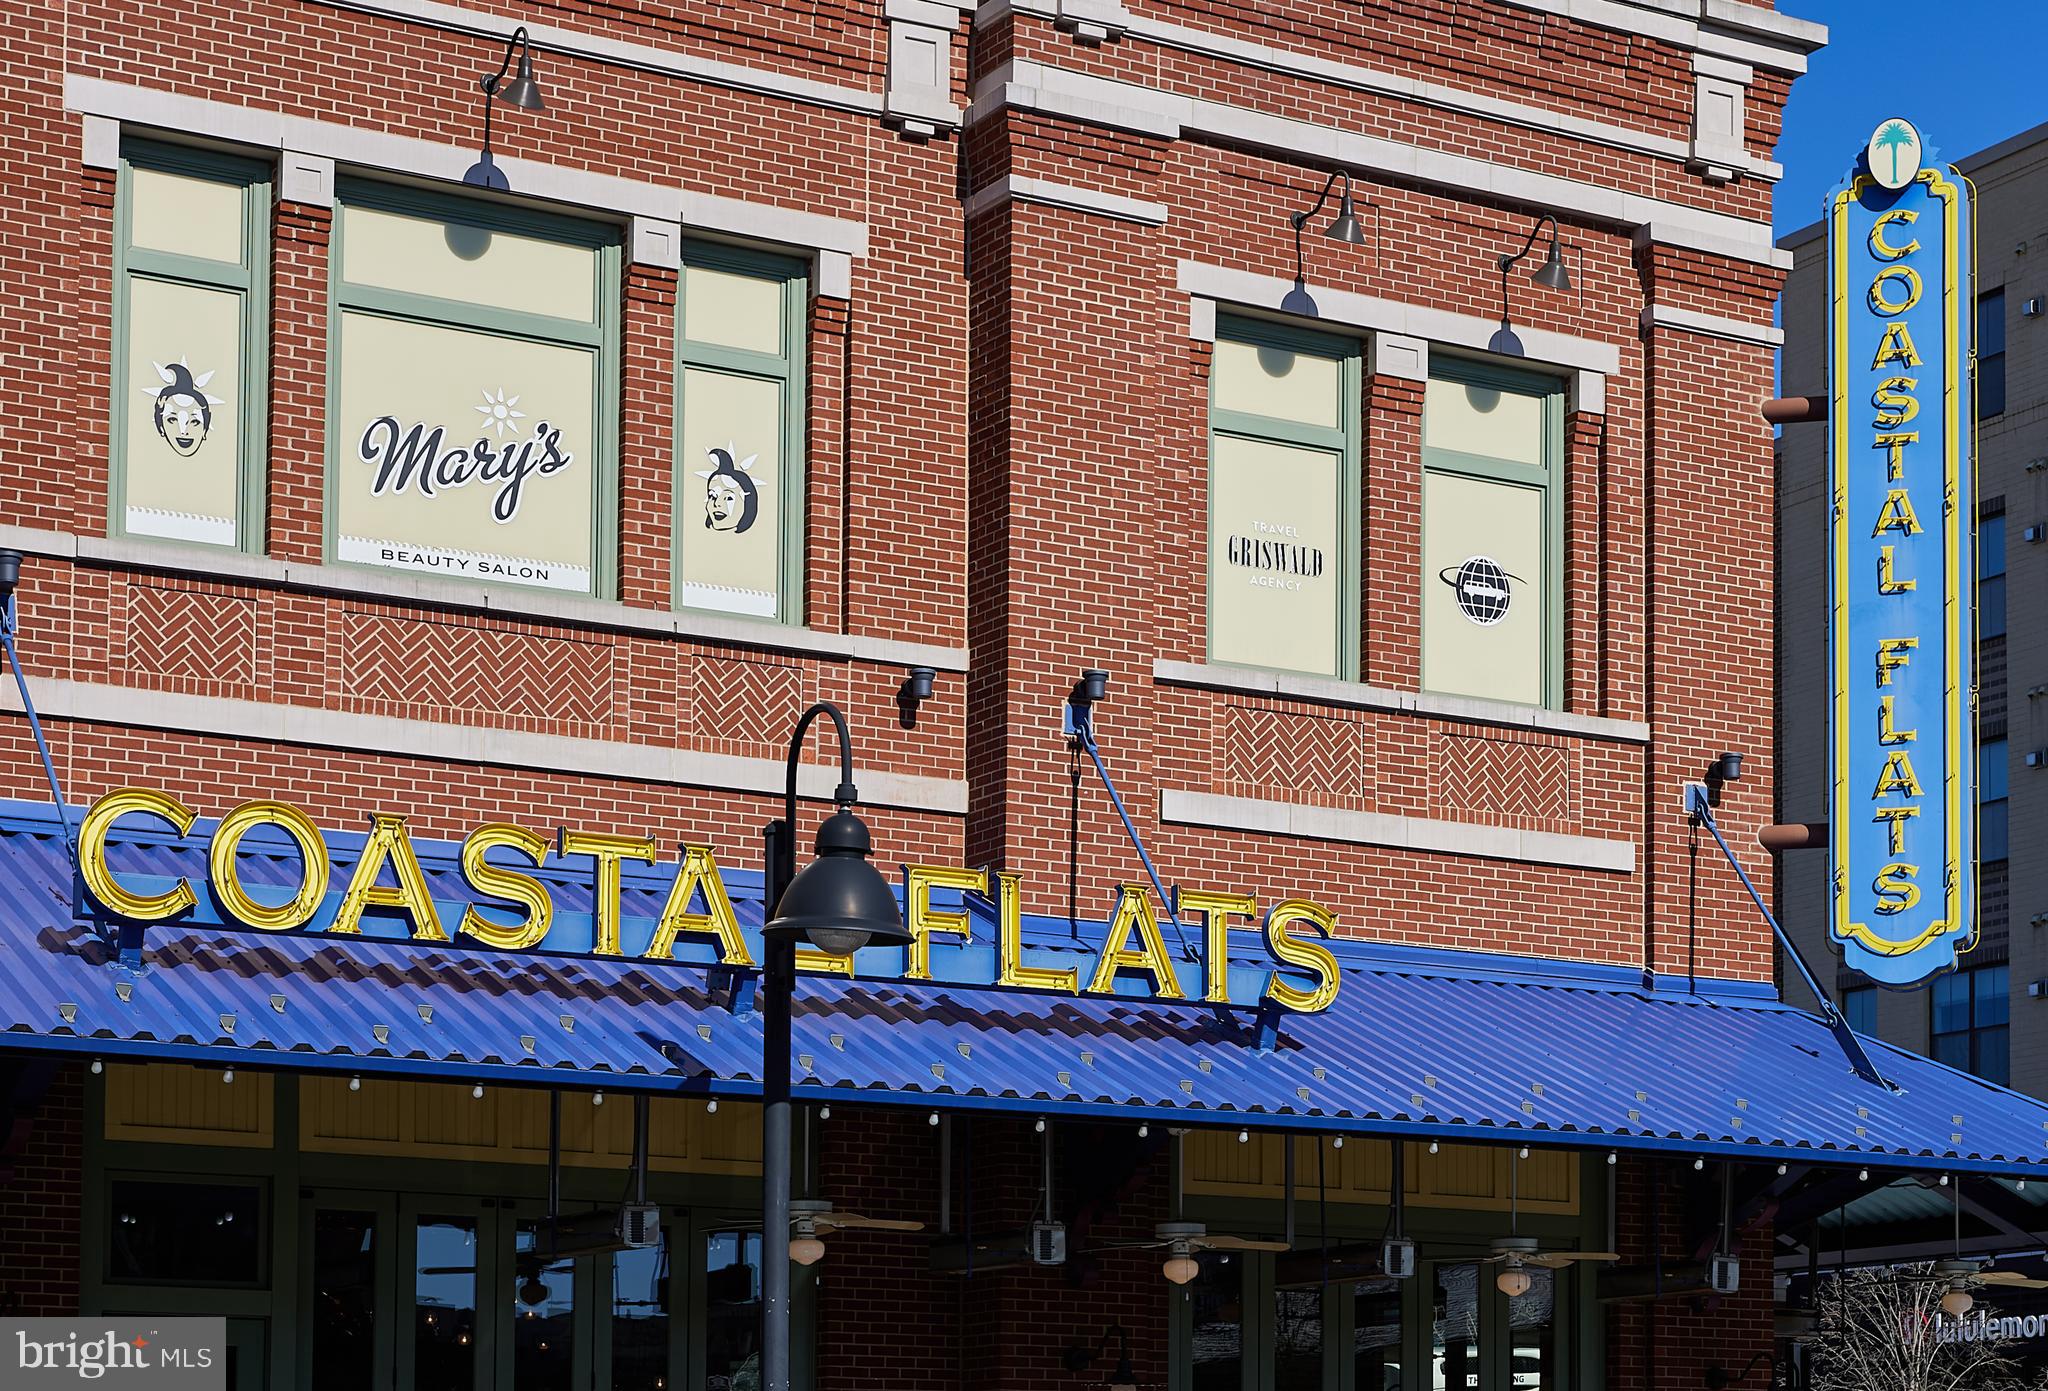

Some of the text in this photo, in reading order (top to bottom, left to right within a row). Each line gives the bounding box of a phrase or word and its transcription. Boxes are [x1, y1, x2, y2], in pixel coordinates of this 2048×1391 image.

[360, 416, 571, 522] Mary's
[1252, 520, 1299, 538] TRAVEL
[381, 549, 549, 580] BEAUTY SALON
[1228, 534, 1323, 578] GRISWALD
[1869, 210, 1925, 914] COASTAL FLATS
[1249, 575, 1302, 591] AGENCY
[77, 787, 1342, 1013] COASTA FLATS
